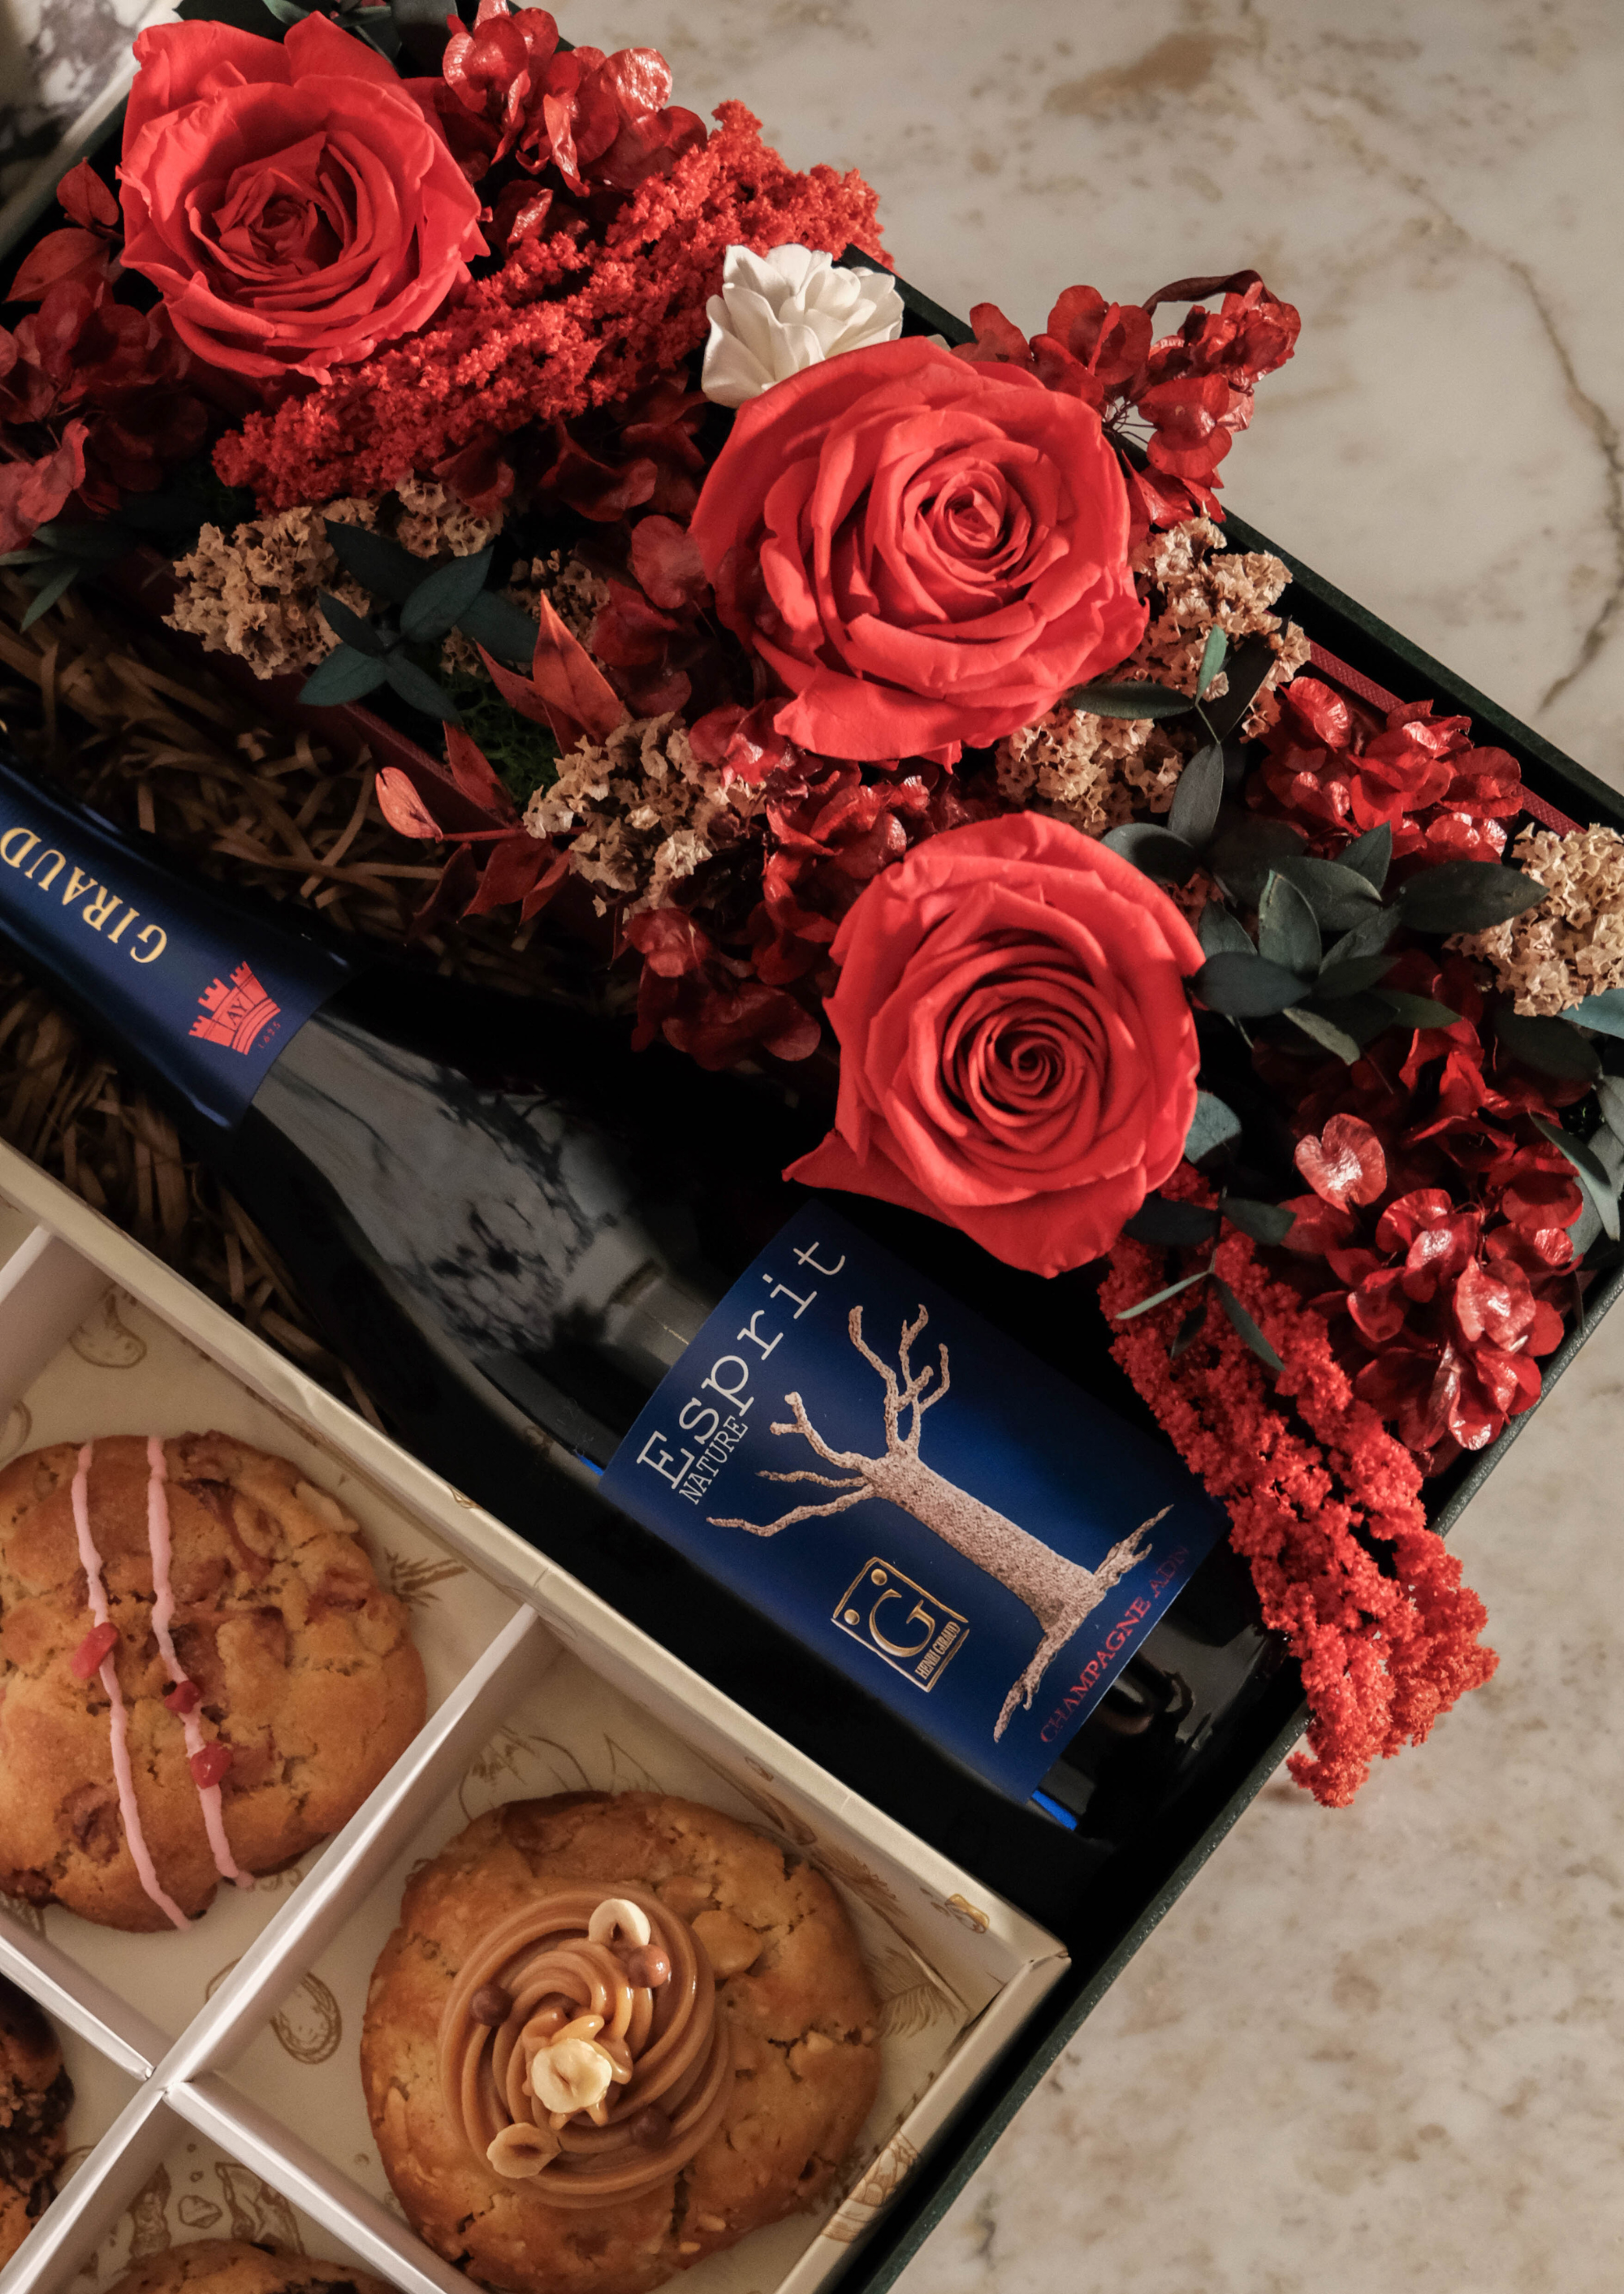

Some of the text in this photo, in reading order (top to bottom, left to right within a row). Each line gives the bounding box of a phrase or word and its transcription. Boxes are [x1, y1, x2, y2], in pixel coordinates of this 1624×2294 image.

[0, 827, 167, 964] GIRAUD
[637, 1242, 845, 1489] Esprit
[679, 1415, 749, 1505] NATURE
[869, 1589, 935, 1657] G
[915, 1622, 961, 1679] HENRI GIRAUD
[1040, 1596, 1151, 1743] CHAMPAGNE
